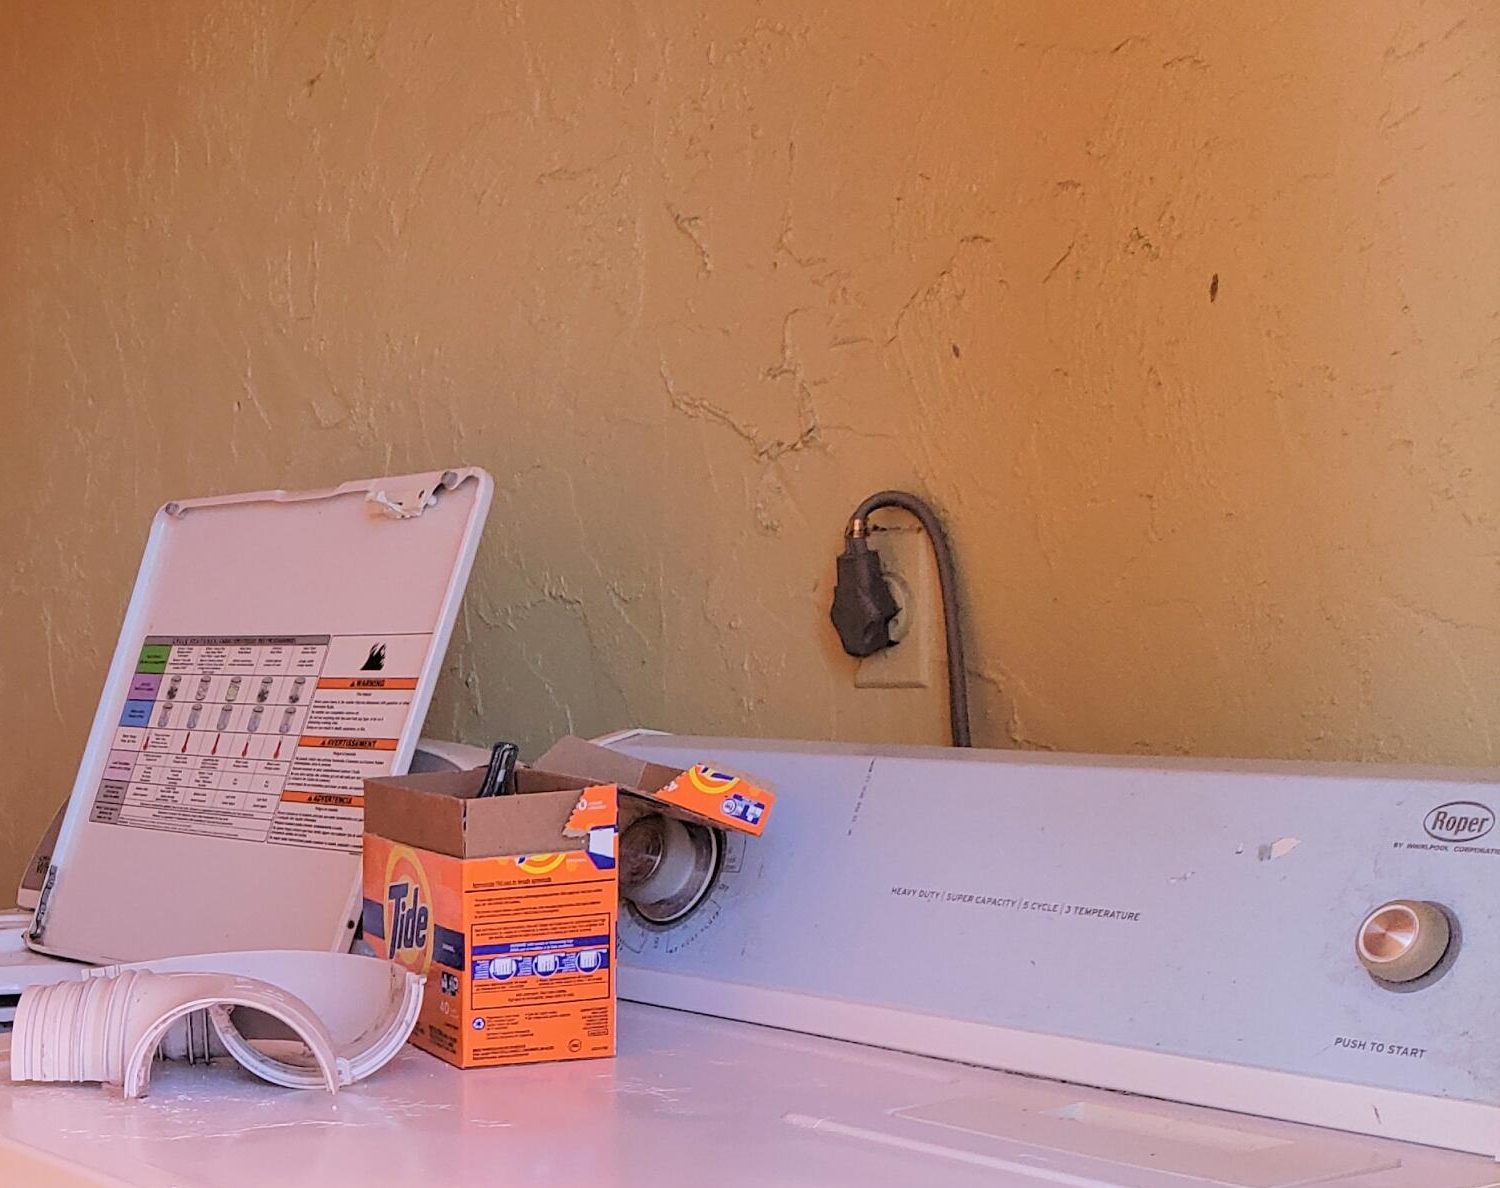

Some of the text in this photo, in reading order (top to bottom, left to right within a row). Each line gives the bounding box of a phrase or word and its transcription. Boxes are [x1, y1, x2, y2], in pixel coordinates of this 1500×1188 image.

[1431, 810, 1490, 836] Roper
[891, 887, 1141, 921] HEAVY DUTY SUPER CAPACITY 5 CYCLE 3 TEMPERATURE
[388, 884, 428, 959] Tide
[1333, 1037, 1427, 1059] PUSH TO START
